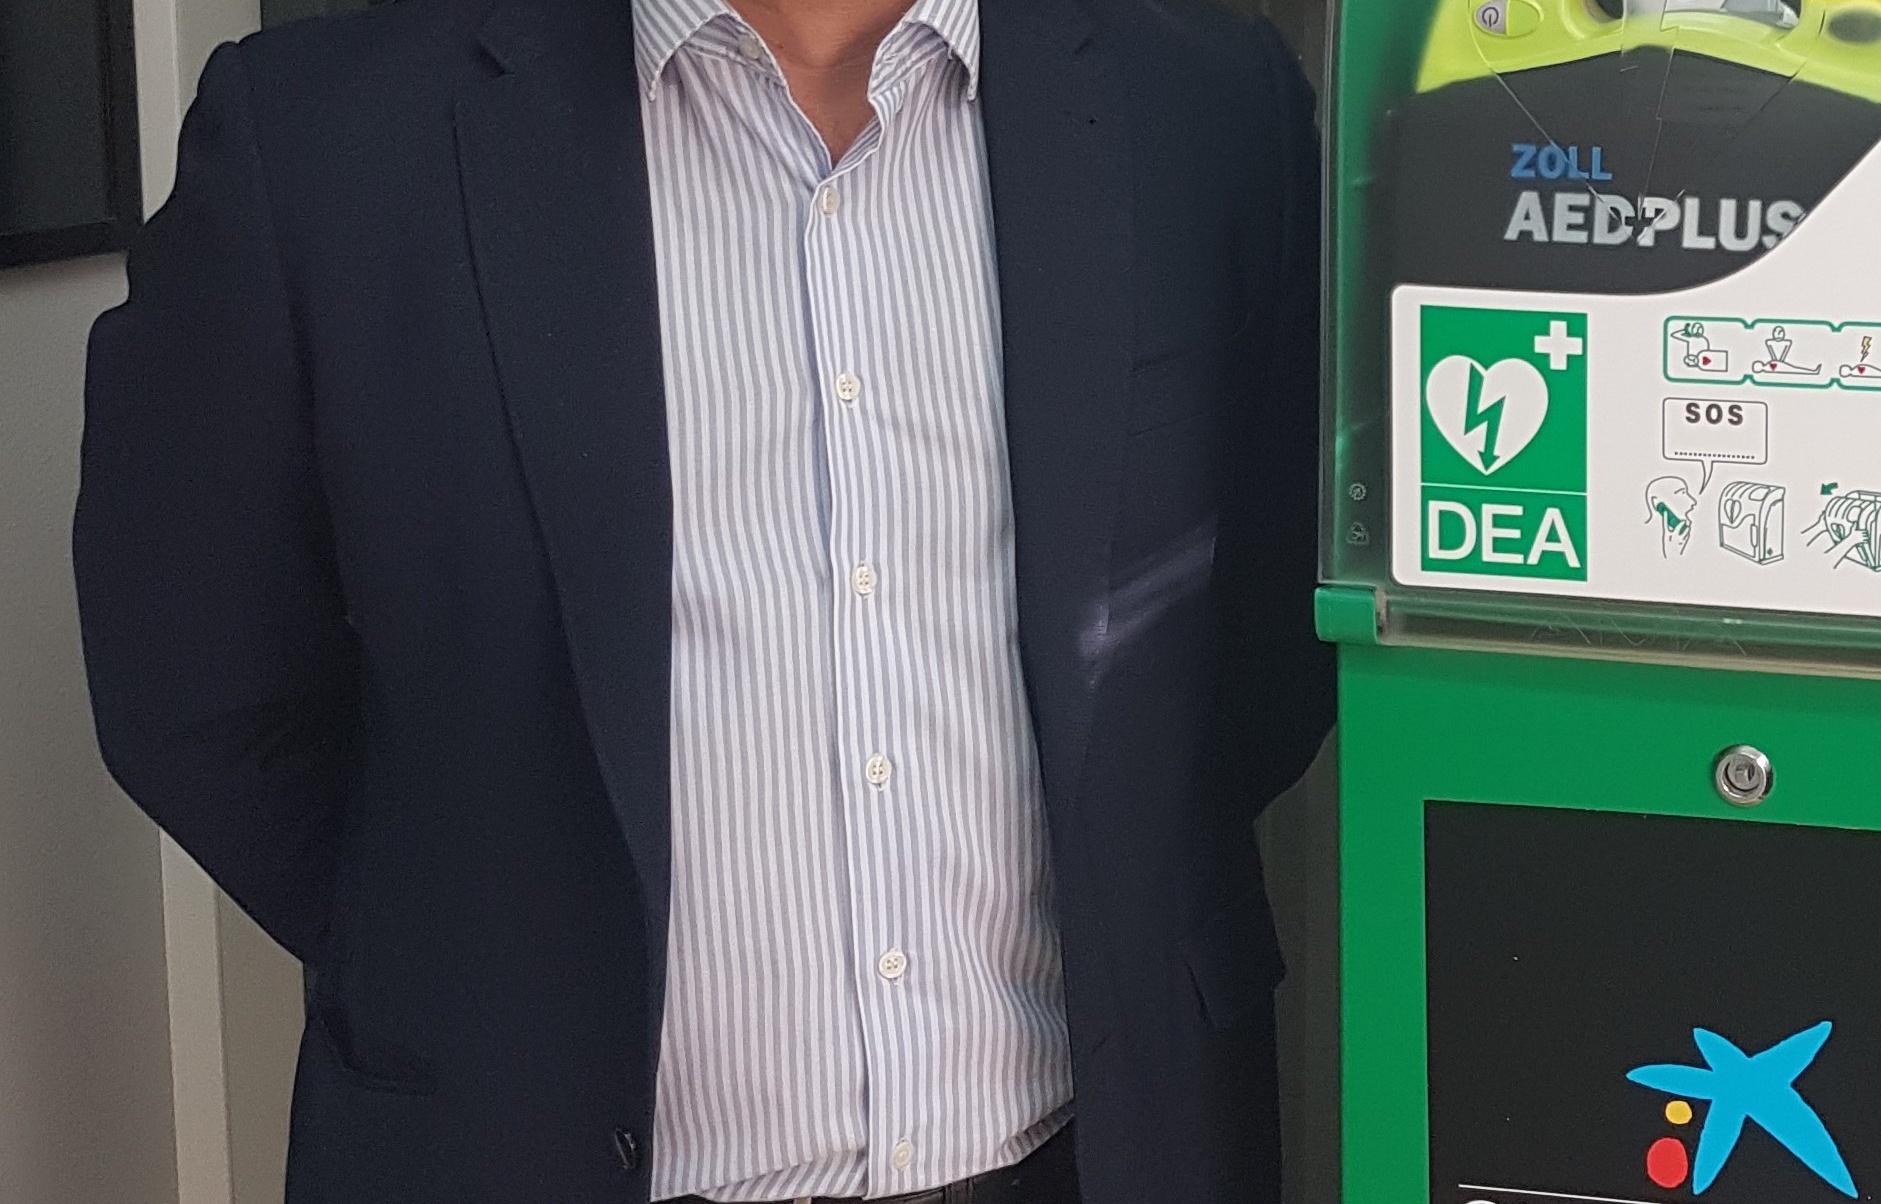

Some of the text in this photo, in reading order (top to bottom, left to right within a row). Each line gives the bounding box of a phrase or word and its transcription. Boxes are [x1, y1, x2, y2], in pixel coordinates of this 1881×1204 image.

[1510, 143, 1613, 180] ZOLL
[1685, 402, 1744, 426] SOS
[1427, 498, 1582, 568] DEA
